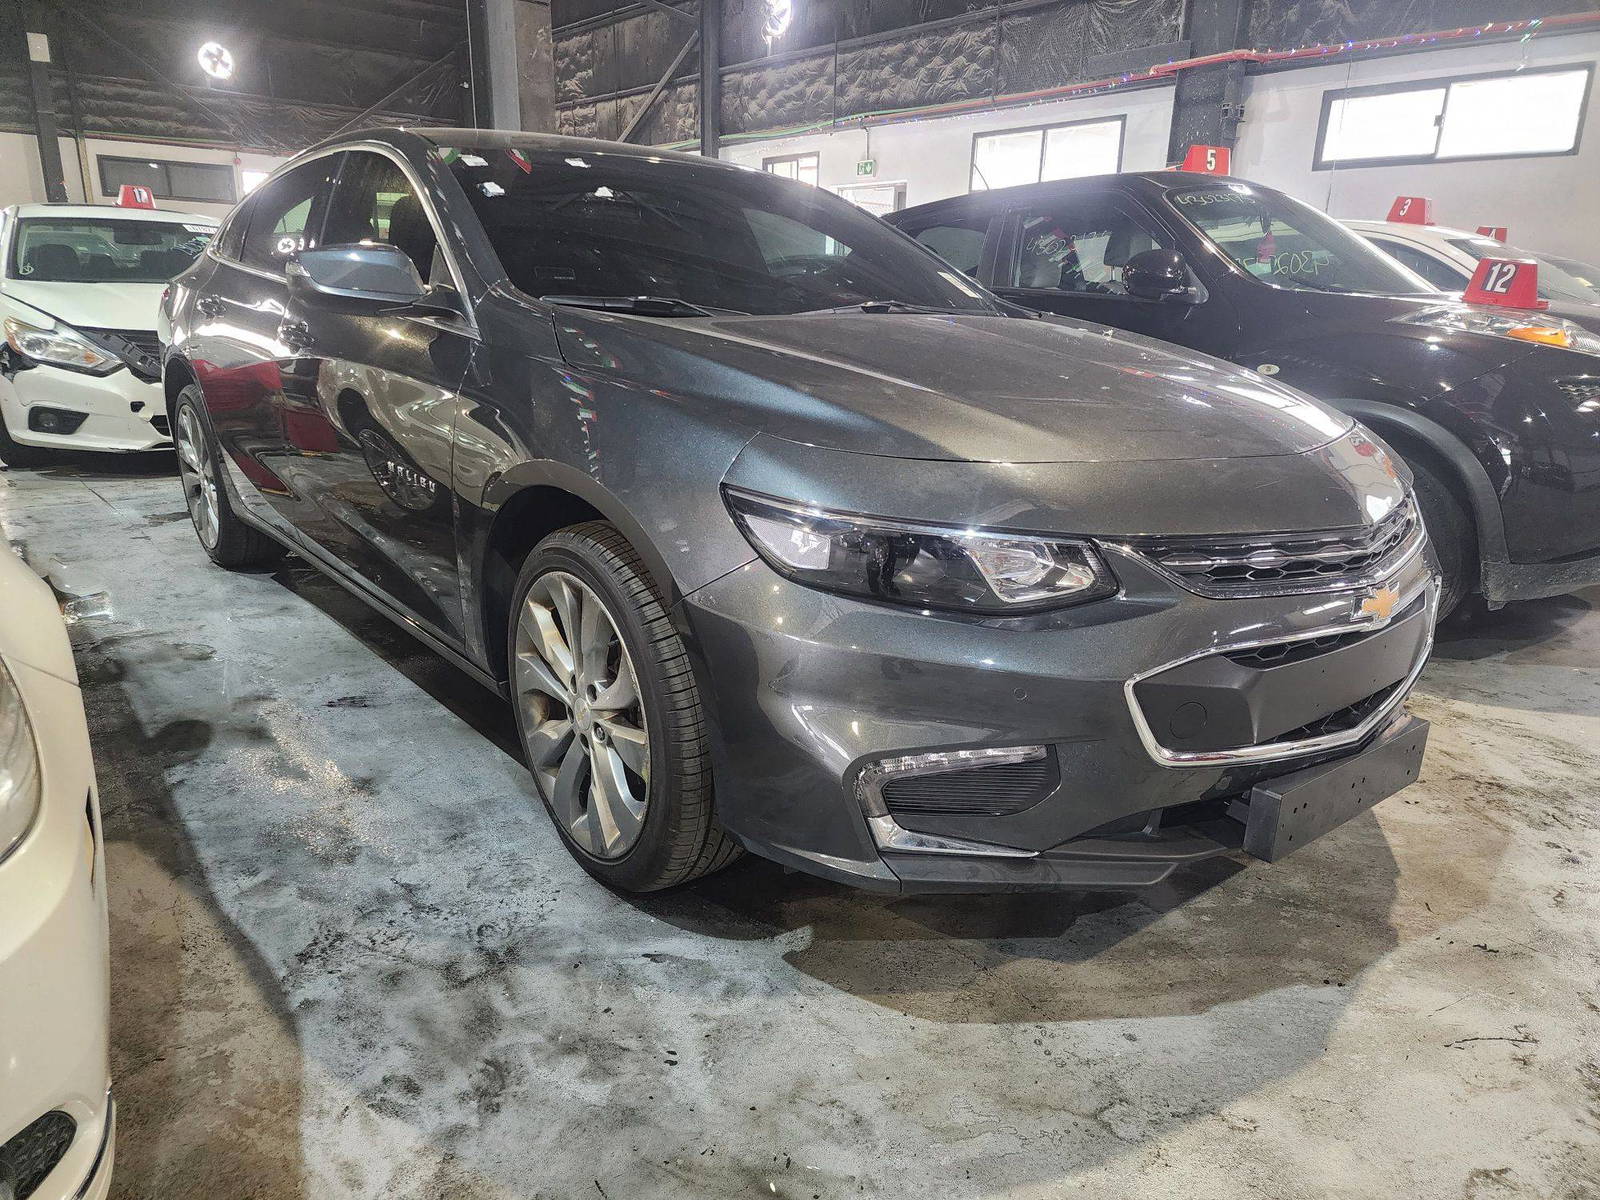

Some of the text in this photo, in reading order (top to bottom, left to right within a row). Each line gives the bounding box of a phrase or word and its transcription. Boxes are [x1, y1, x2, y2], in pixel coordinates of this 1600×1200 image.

[1206, 149, 1216, 171] 5
[1399, 198, 1412, 216] 3
[1485, 262, 1516, 293] 12
[387, 461, 436, 492] MALIBU
